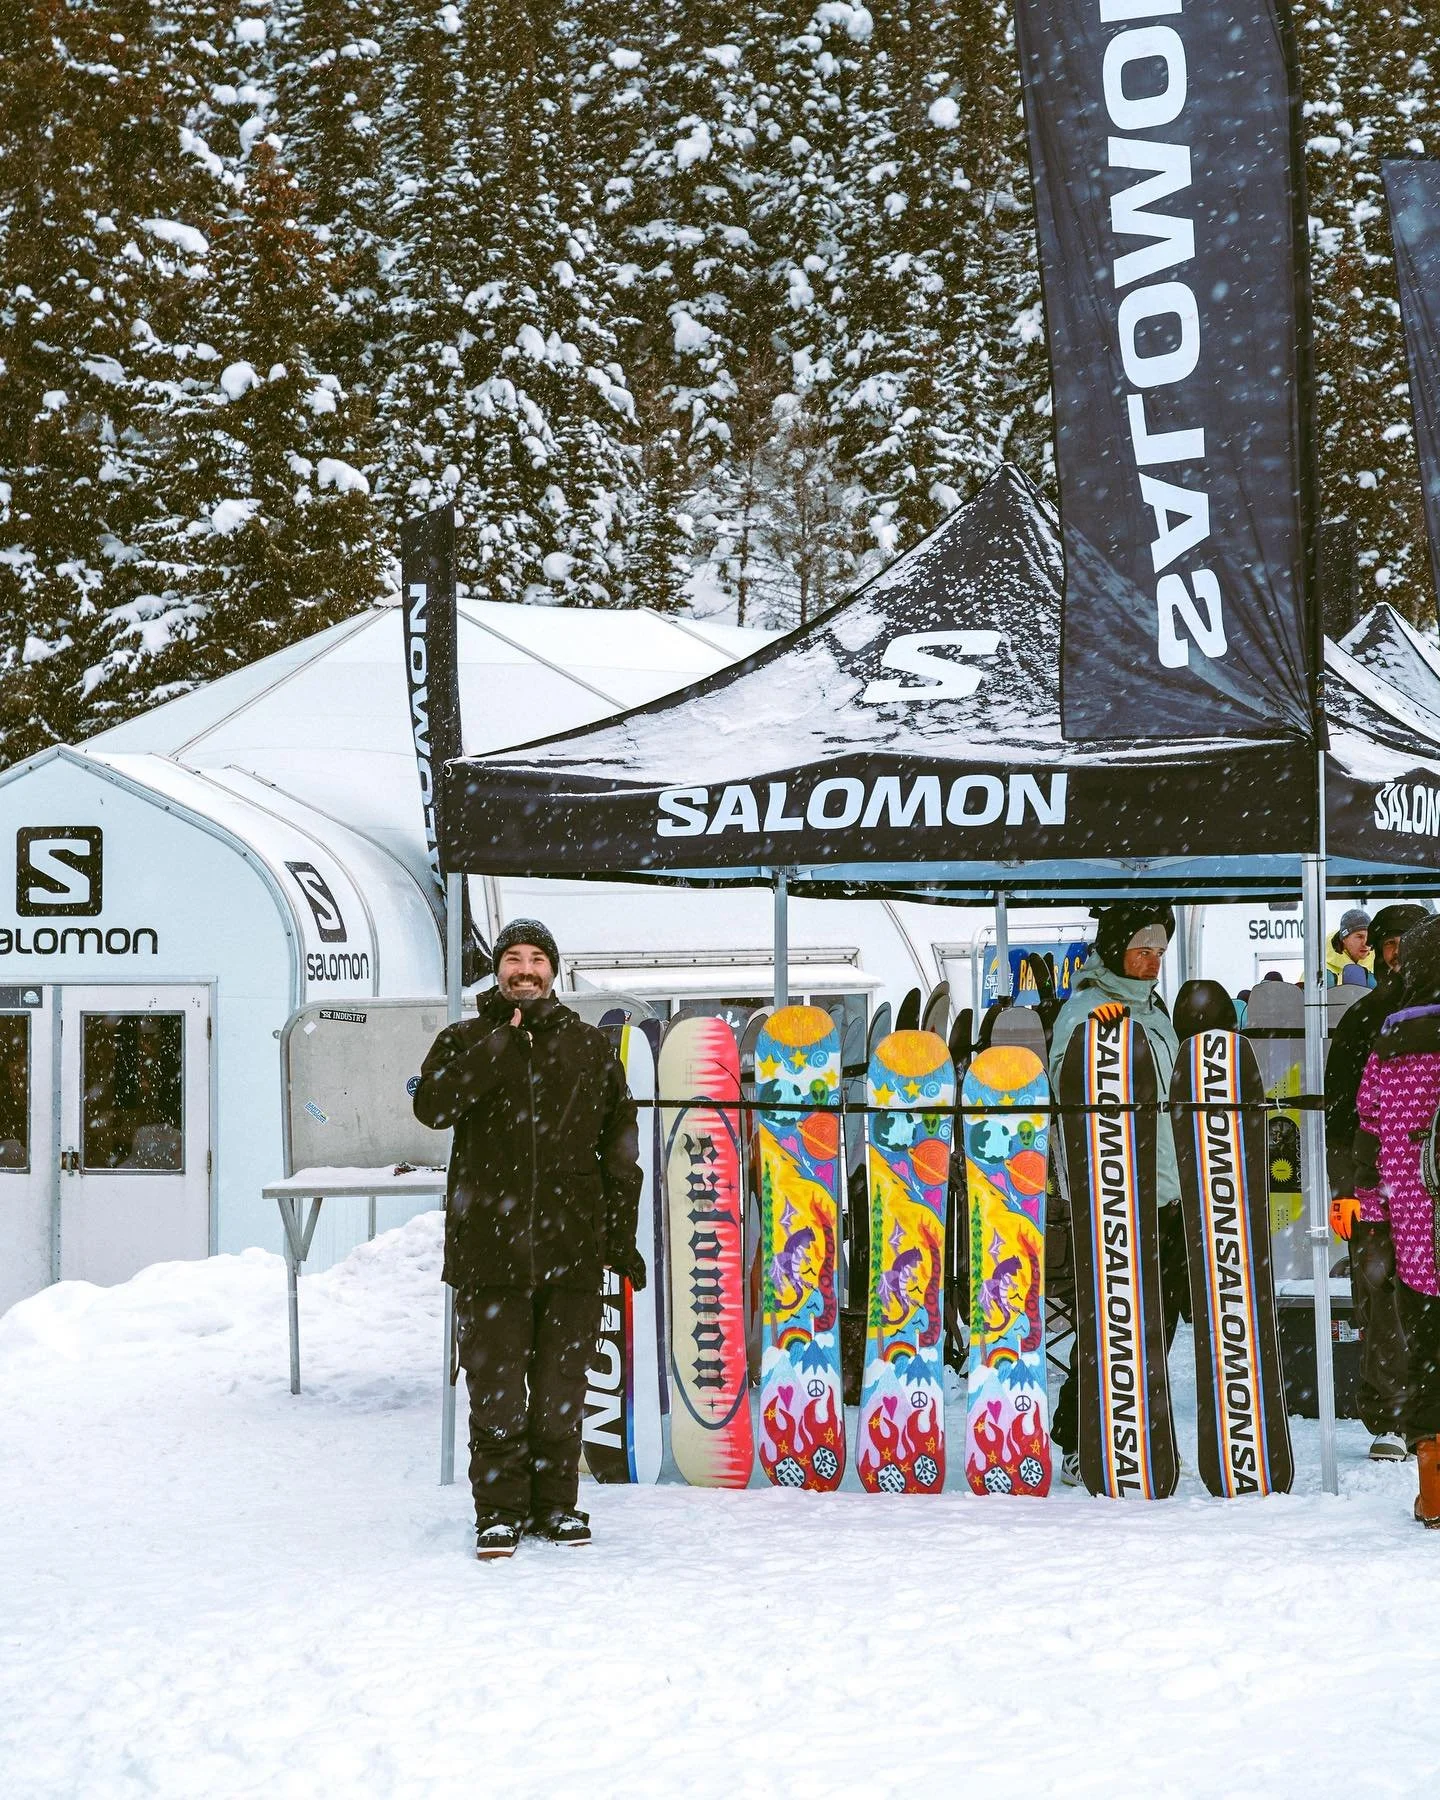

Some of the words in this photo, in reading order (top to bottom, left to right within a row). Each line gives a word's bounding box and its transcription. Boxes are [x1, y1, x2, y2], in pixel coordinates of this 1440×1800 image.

[863, 630, 1003, 703] S
[656, 773, 1069, 838] SALOMON
[306, 952, 370, 982] salomon
[333, 1010, 366, 1023] INDUSTRY
[683, 1132, 739, 1392] salomon
